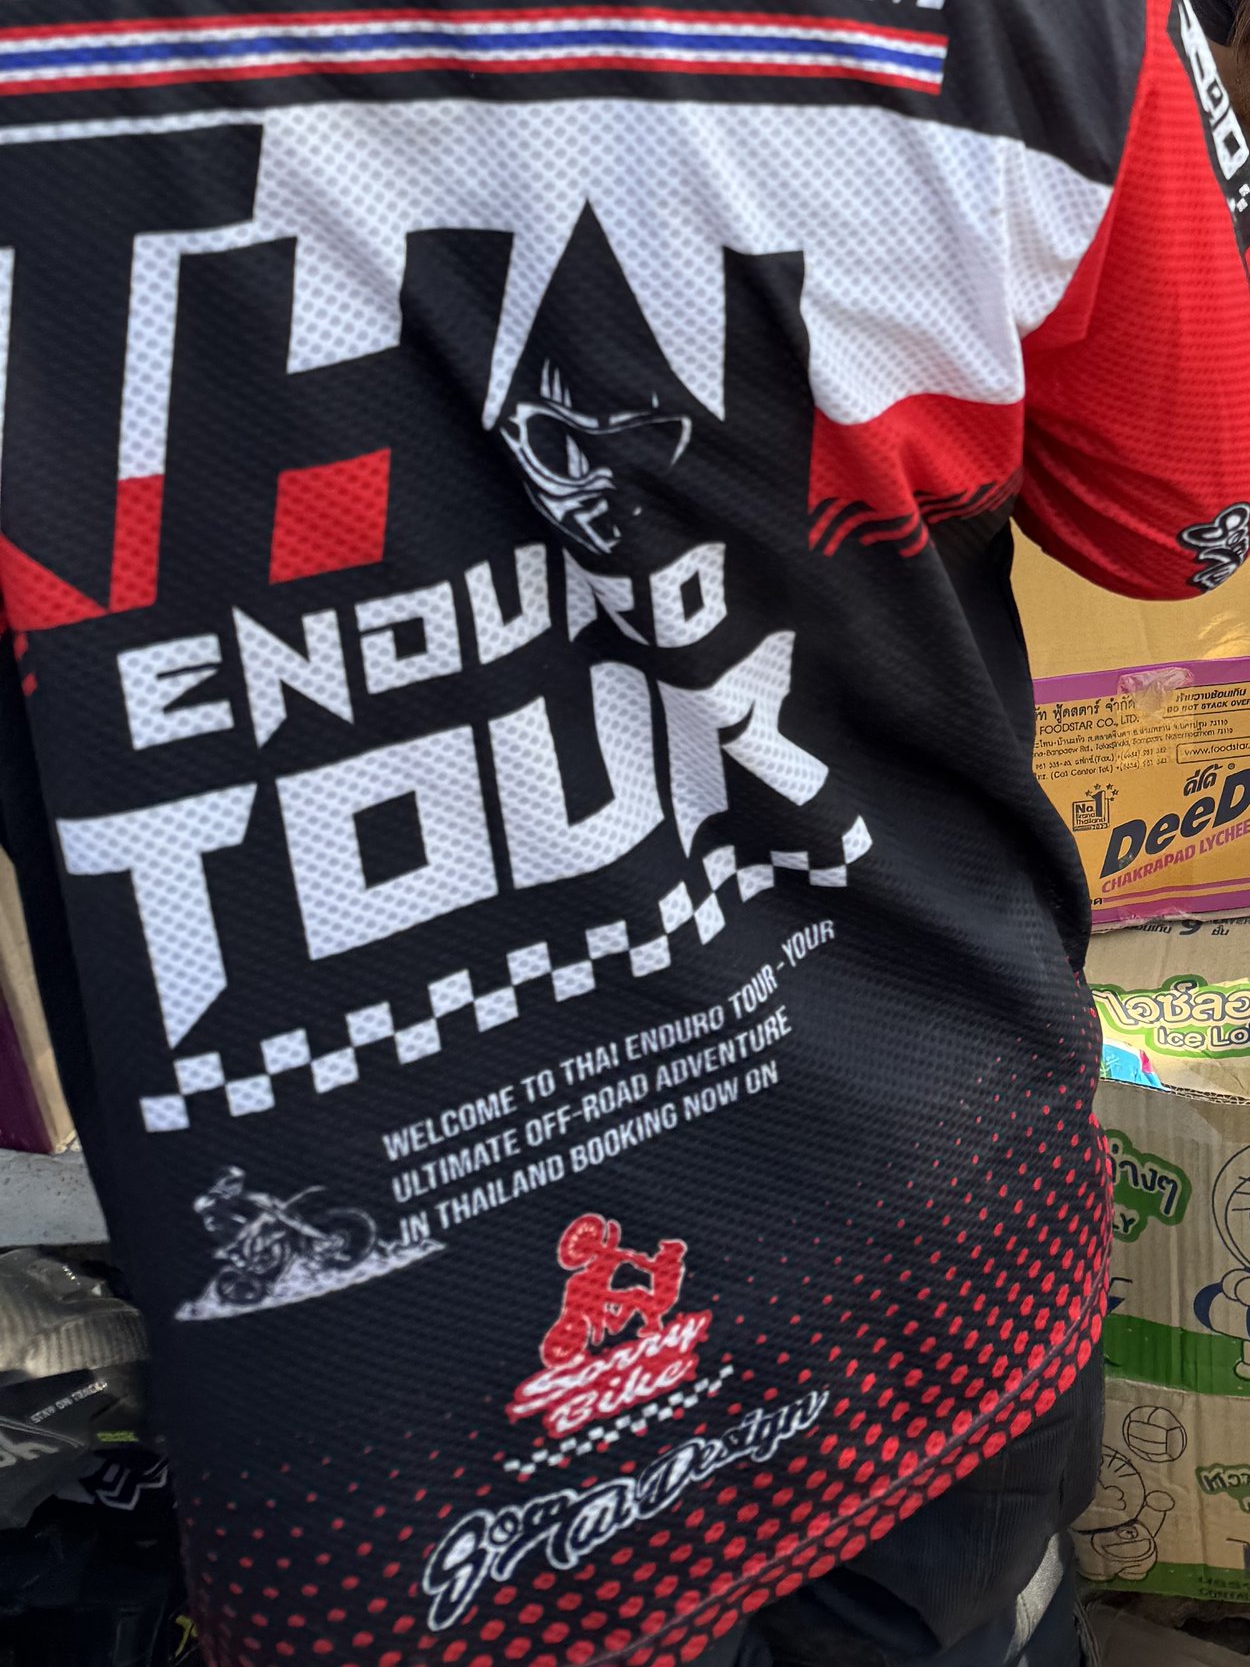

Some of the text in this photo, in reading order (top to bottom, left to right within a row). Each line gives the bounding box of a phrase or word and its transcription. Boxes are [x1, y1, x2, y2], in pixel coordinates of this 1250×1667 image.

[116, 542, 727, 751] ENDURO
[1182, 704, 1199, 712] NOT
[1201, 700, 1229, 710] STACK
[1039, 722, 1093, 736] FOODSTAR
[1120, 714, 1140, 725] LTD.
[56, 630, 830, 1051] TOUR
[1101, 844, 1196, 894] CHAKRAPAD
[383, 1086, 518, 1161] WELCOME
[521, 1068, 556, 1104] TO
[560, 1041, 620, 1084] THAI
[626, 1005, 725, 1062] ENDURO
[728, 964, 779, 1021] TOUR
[782, 919, 836, 967] YOUR
[1156, 1025, 1205, 1049] Ice
[392, 1004, 793, 1203] ULTIMATE OFF-ROAD ADVENTURE
[400, 1060, 779, 1246] IN THAILAND BOOKING NOW ON
[550, 1360, 694, 1433] Bike
